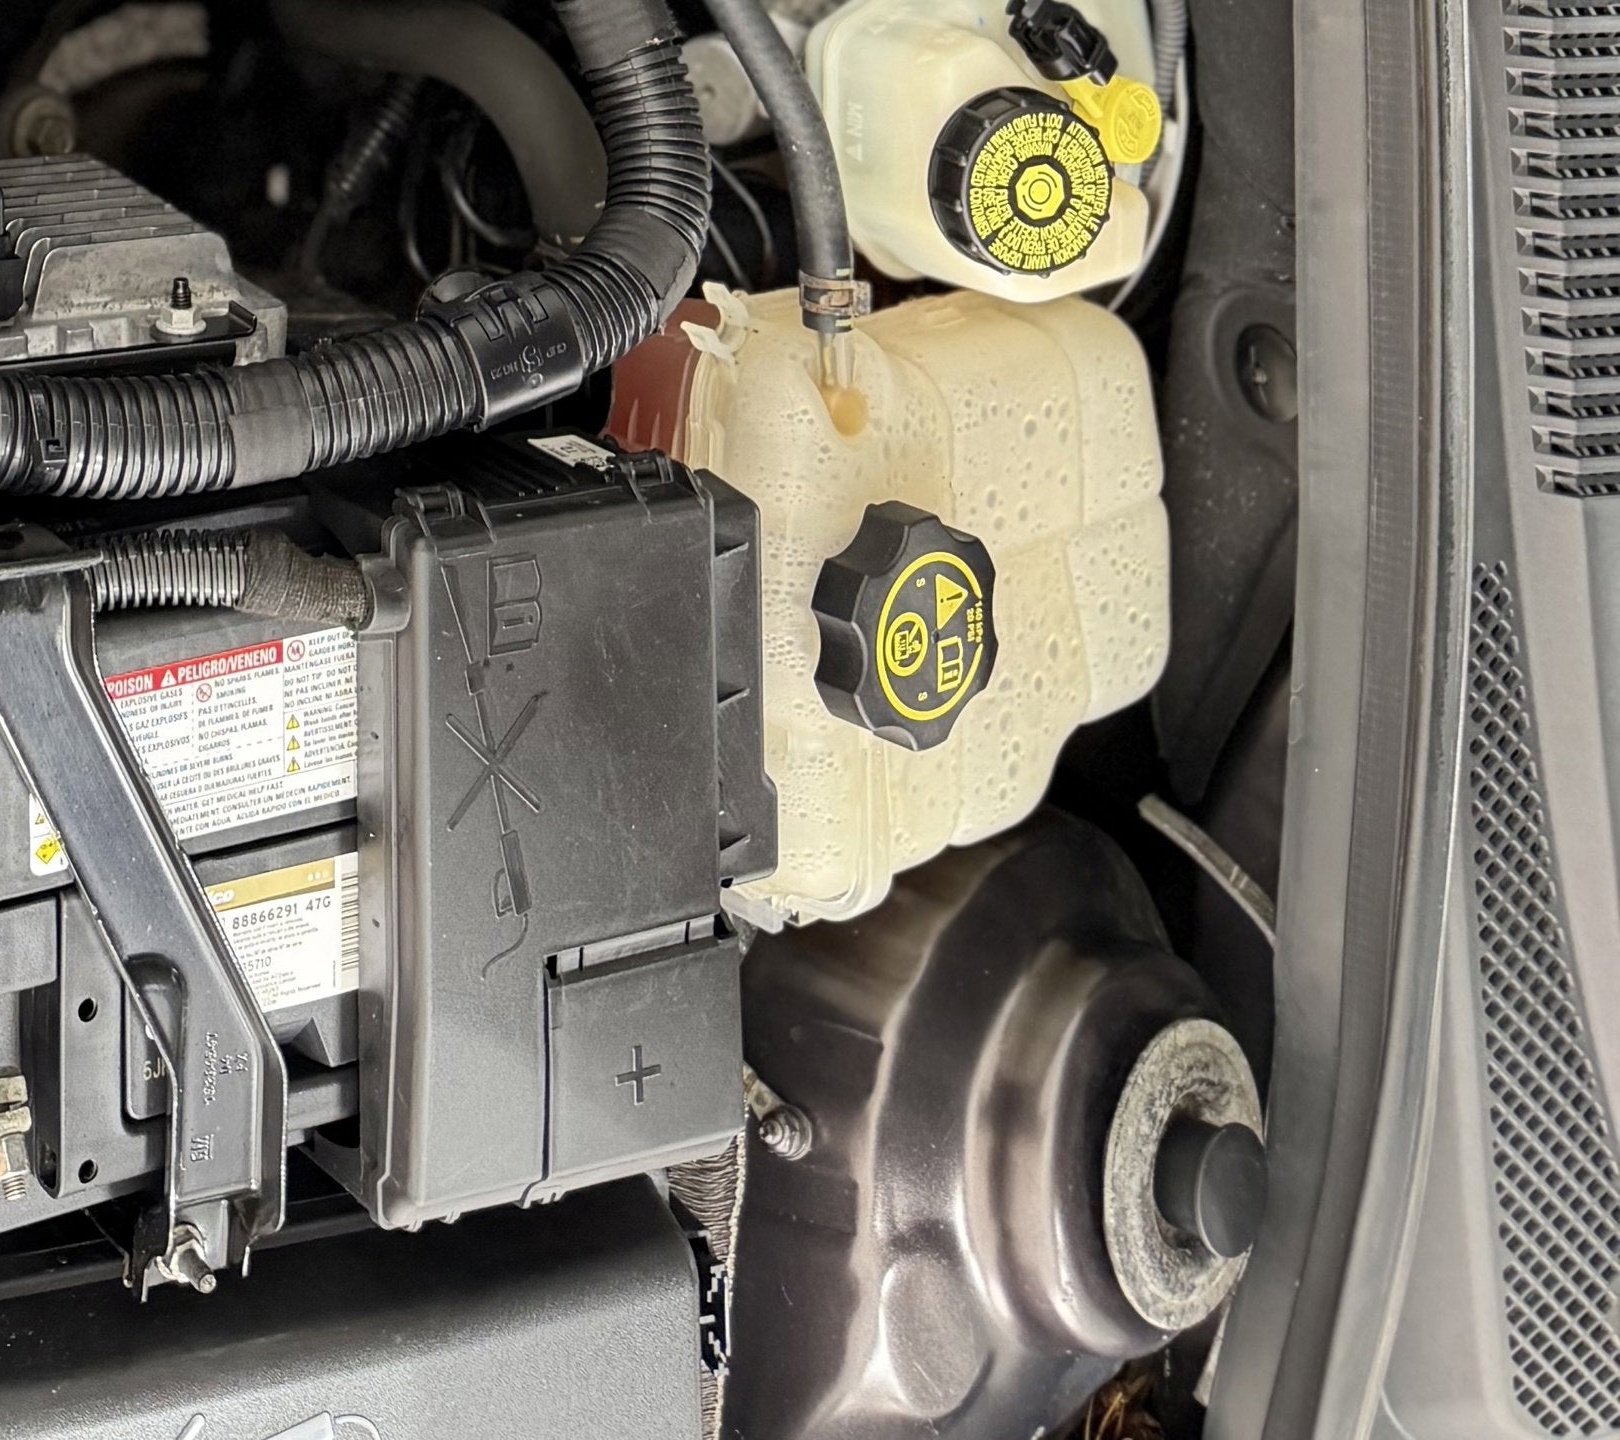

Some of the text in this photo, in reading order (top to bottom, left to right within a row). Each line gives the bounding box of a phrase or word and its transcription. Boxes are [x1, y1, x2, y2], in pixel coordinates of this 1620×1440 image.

[1065, 121, 1103, 165] ATTENTION
[1090, 164, 1107, 216] NETTOYER
[1048, 230, 1091, 265] BOUCHON
[965, 608, 973, 622] 20
[108, 646, 277, 698] POISON PELIGRO/VENENO
[232, 896, 331, 930] 88866291 47G
